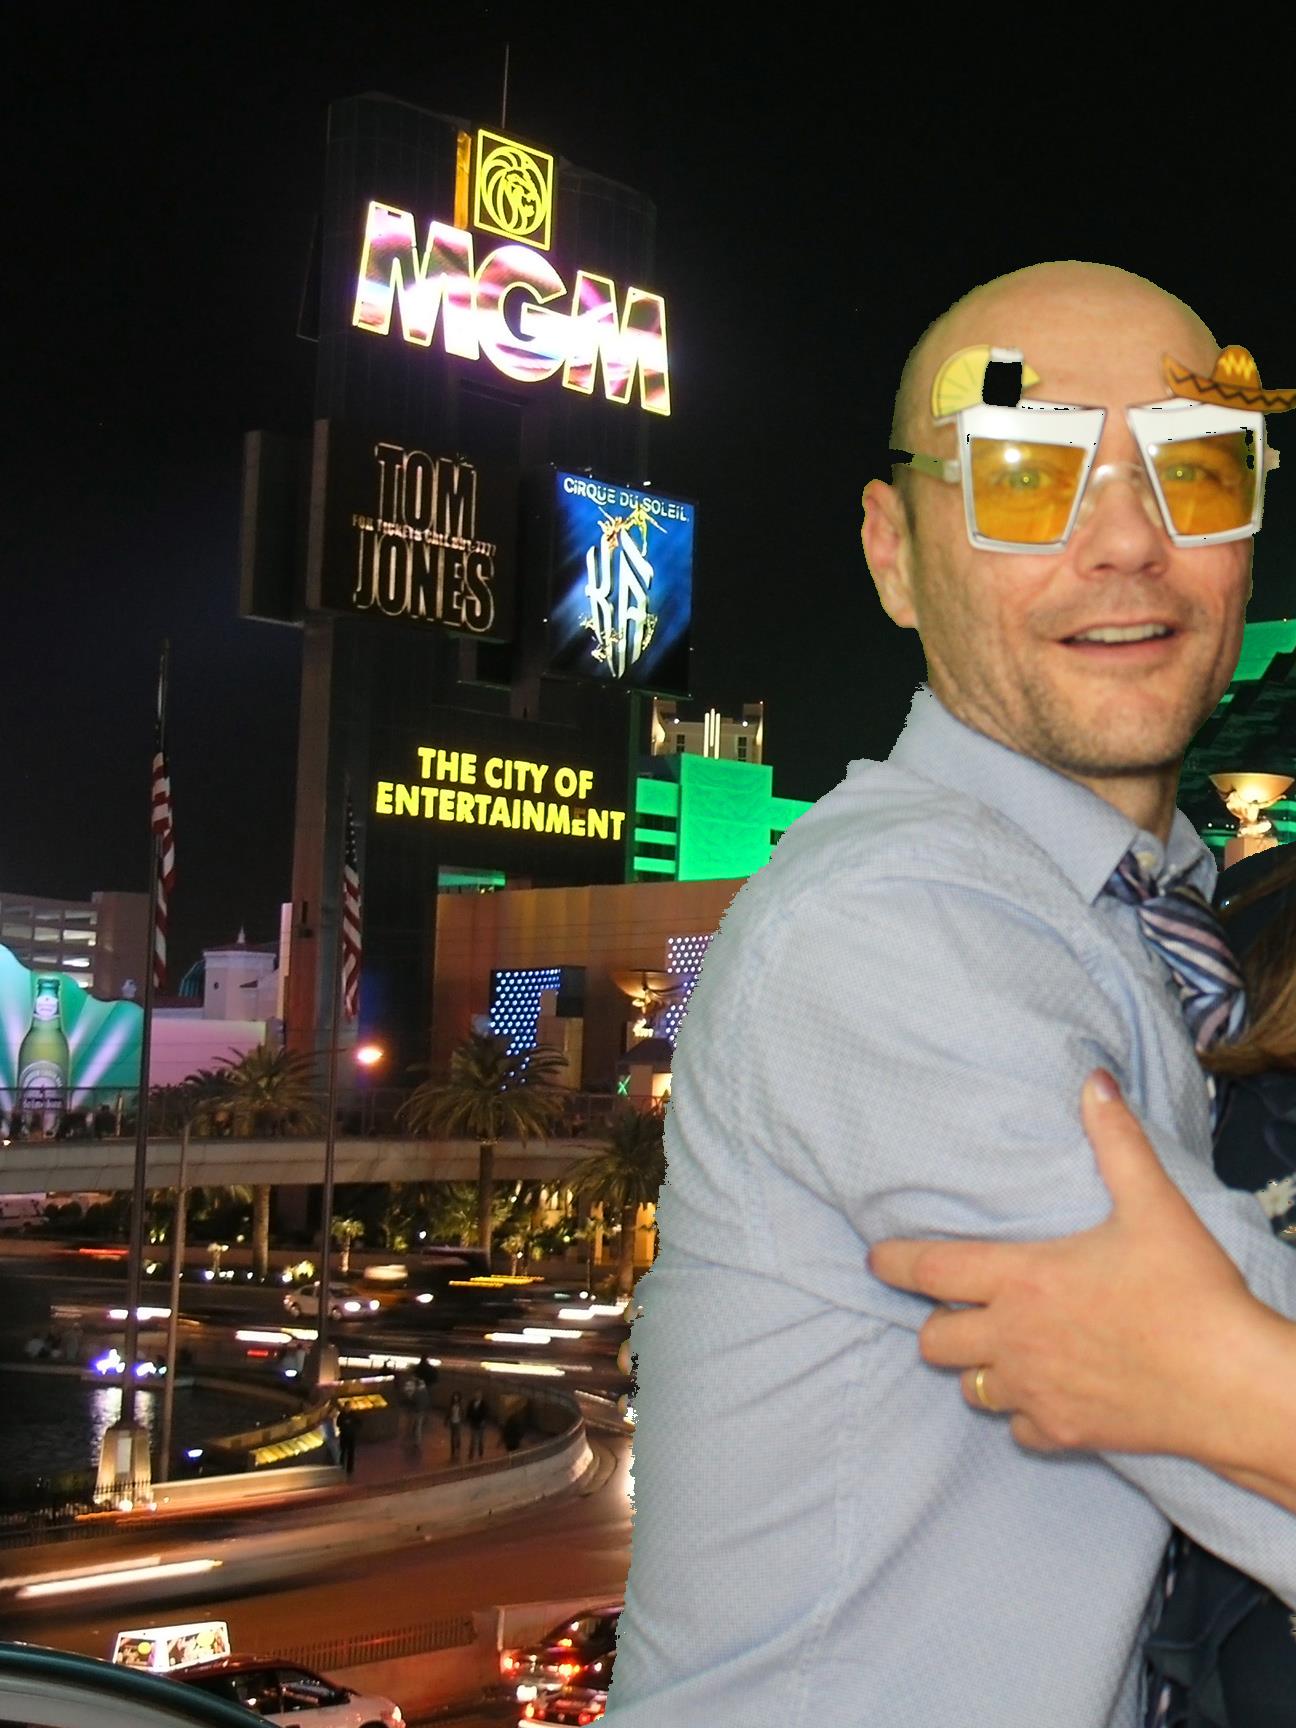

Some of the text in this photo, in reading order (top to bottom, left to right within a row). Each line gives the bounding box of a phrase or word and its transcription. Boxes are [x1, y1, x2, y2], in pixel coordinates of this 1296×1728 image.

[352, 200, 671, 416] MGM
[374, 442, 478, 540] TOM
[563, 477, 616, 506] CIRQUE
[619, 491, 639, 510] DU
[353, 530, 495, 633] JONES
[376, 781, 626, 841] ENTERTAINMENT
[417, 746, 594, 800] THE CITY OF
